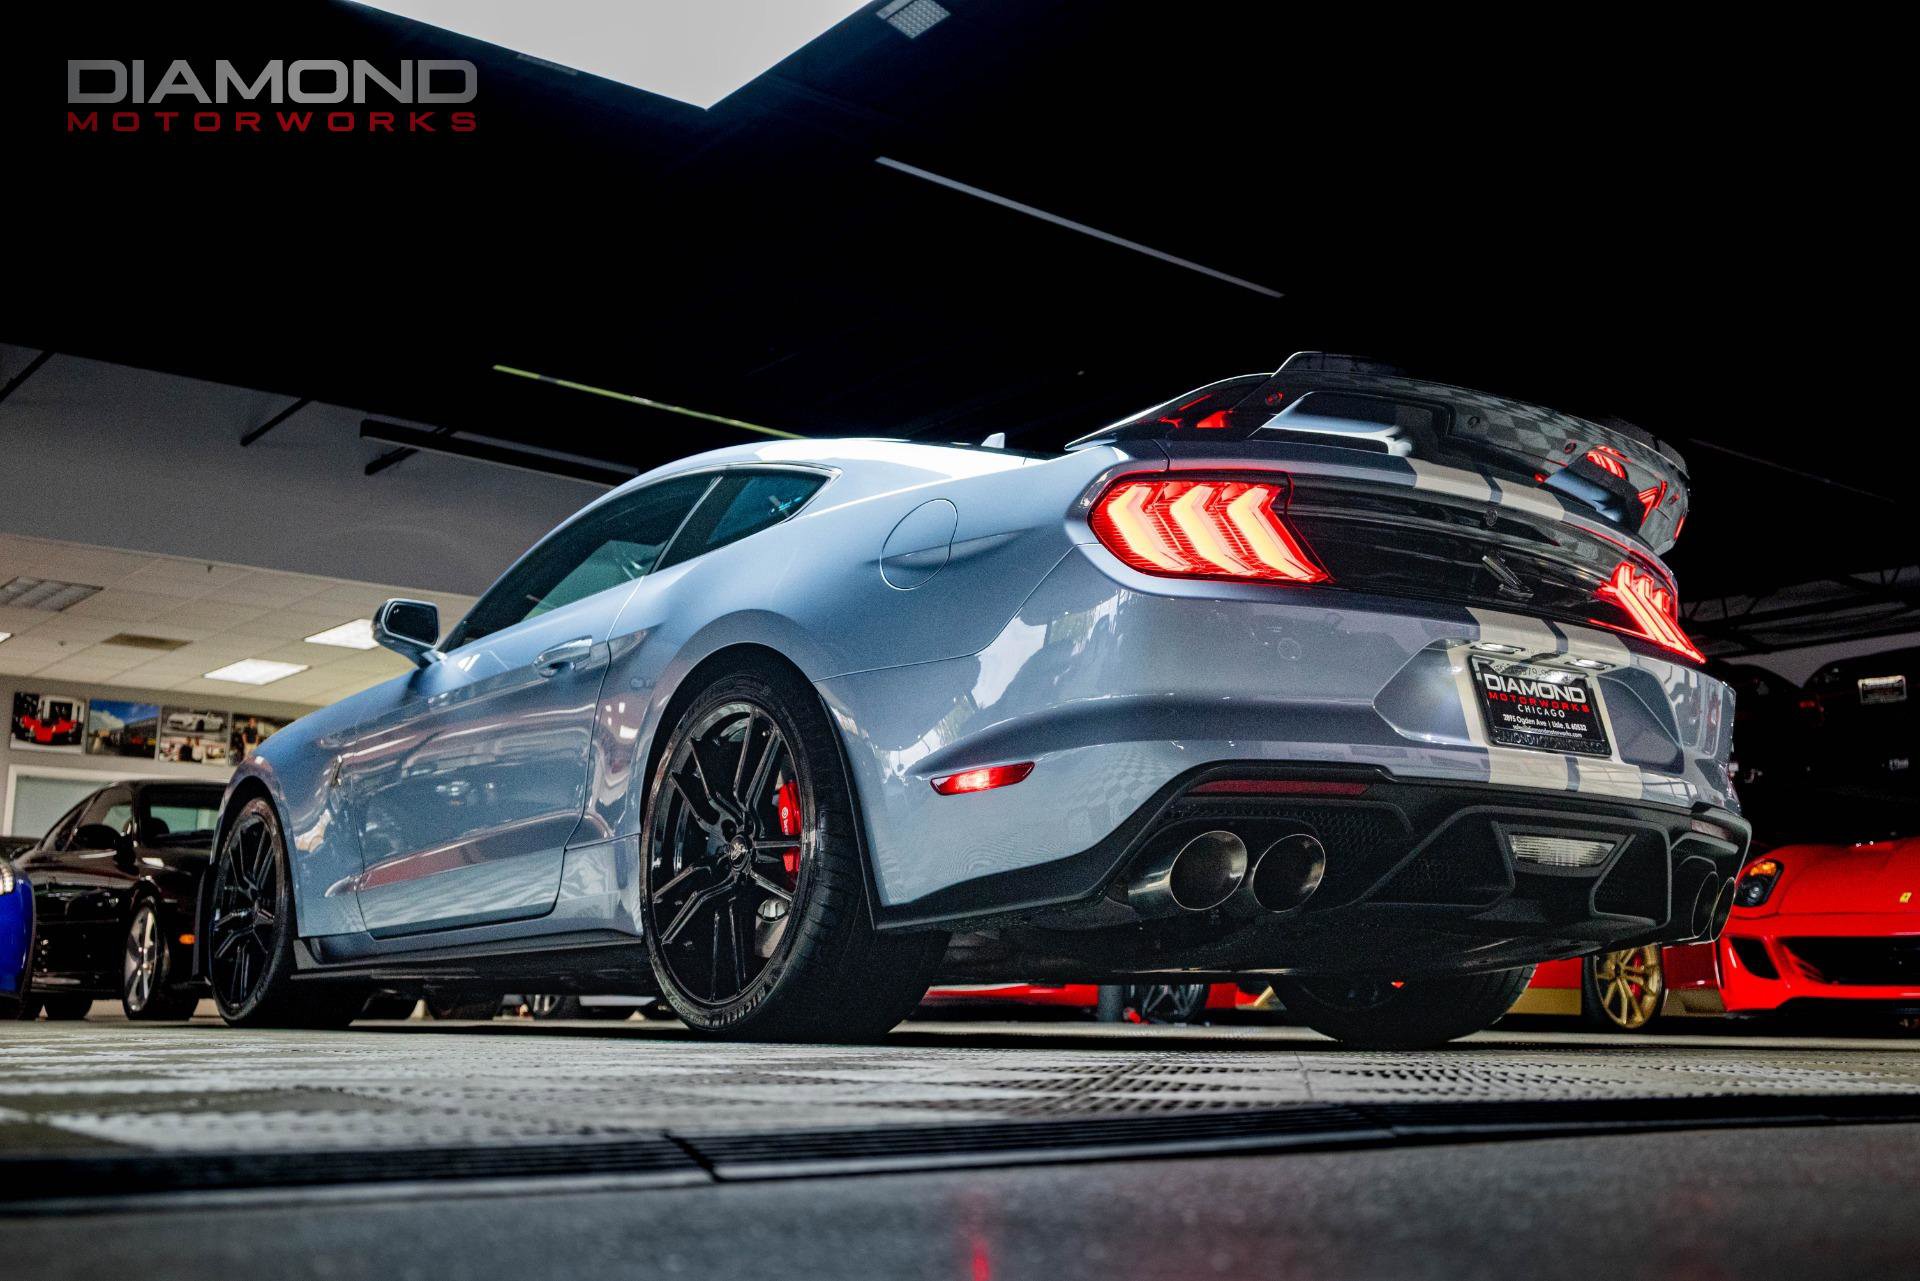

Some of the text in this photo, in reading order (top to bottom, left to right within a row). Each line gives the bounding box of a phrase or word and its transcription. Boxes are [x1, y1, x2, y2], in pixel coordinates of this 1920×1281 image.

[1483, 673, 1587, 703] DIAMOND
[1488, 691, 1590, 713] MOTORWORKS
[1517, 704, 1566, 718] CHICAGO
